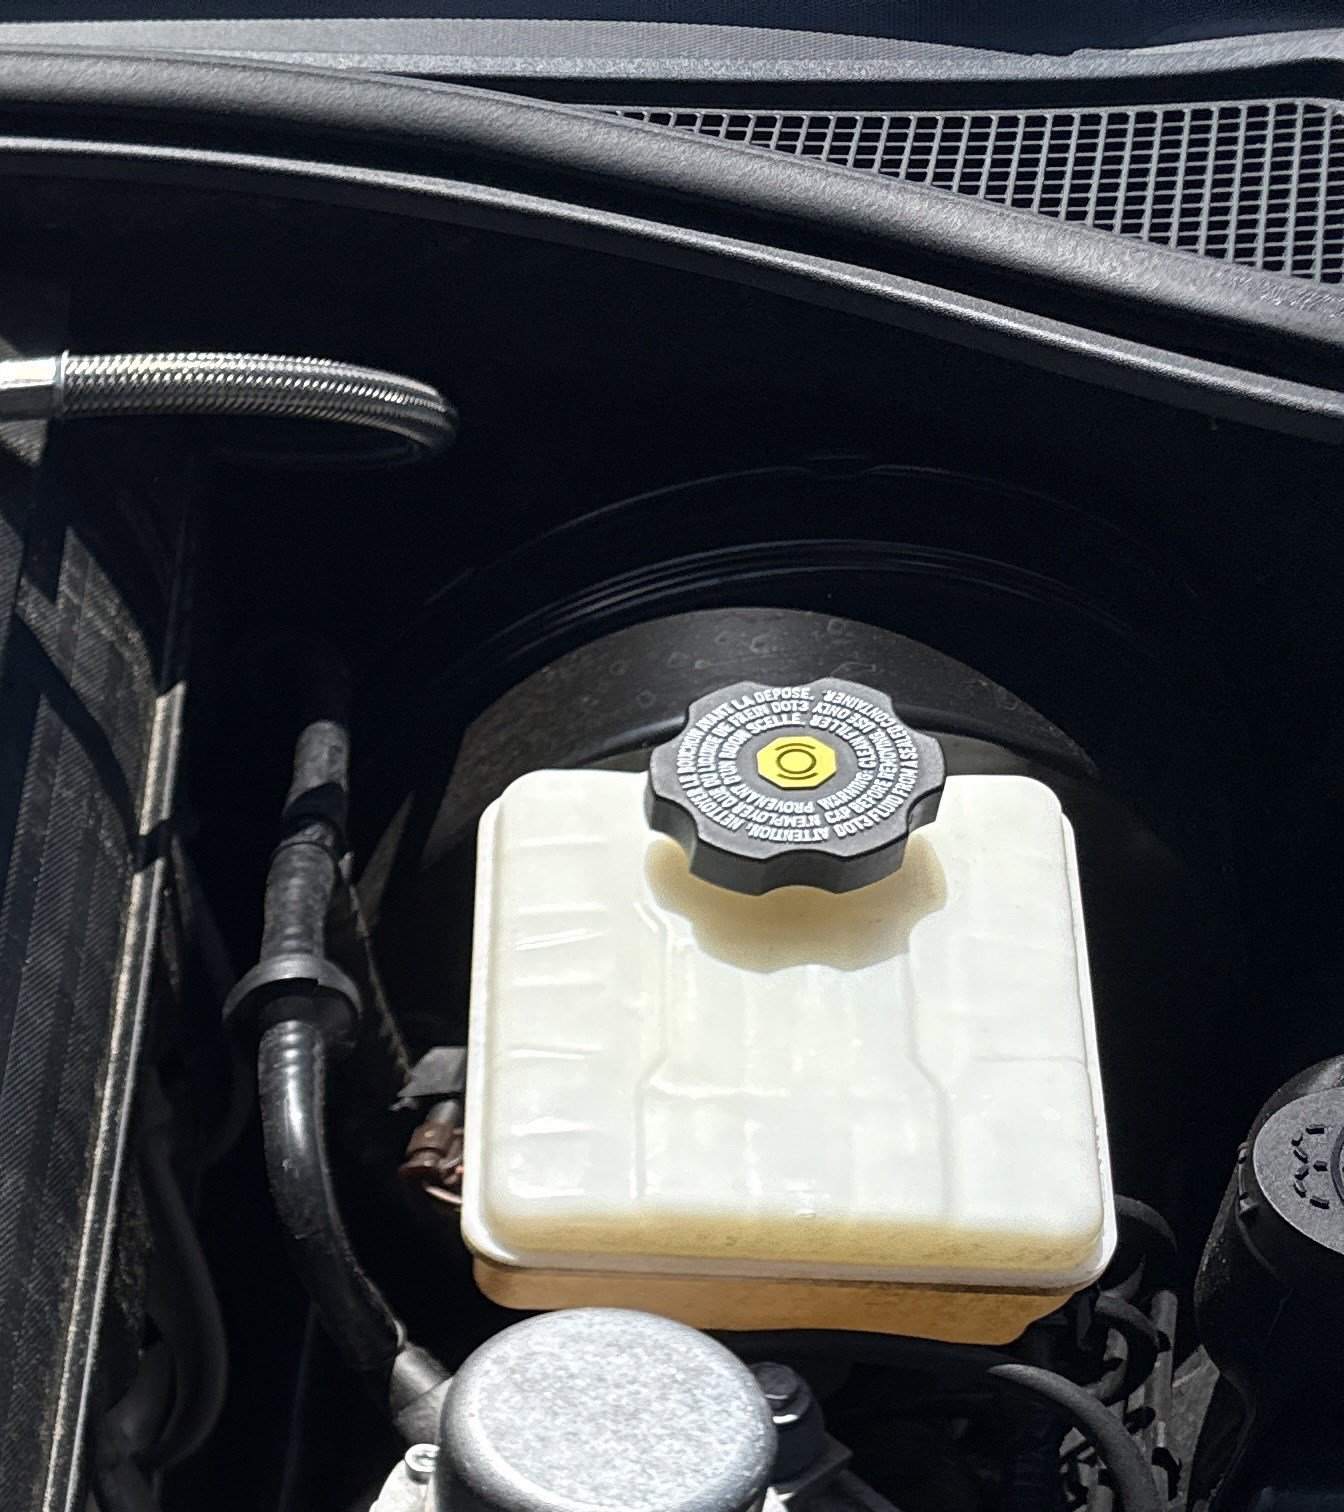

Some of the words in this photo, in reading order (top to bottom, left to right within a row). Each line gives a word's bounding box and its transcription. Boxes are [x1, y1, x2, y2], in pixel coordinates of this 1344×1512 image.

[727, 703, 770, 728] FREIN
[731, 696, 756, 711] LA
[771, 700, 809, 713] DOT3
[812, 701, 854, 721] ONLY
[695, 702, 736, 732] AVANT
[711, 721, 735, 738] DE
[809, 714, 860, 742] FILLER
[847, 712, 878, 734] USE
[677, 727, 705, 774] BOUCHON
[697, 734, 723, 773] LIQUIDE
[848, 736, 878, 769] CLEAN
[886, 726, 918, 761] SEALED
[679, 774, 701, 789] LE
[699, 773, 721, 788] DU
[892, 769, 918, 799] FROM
[686, 787, 746, 832] NETTOYER
[708, 785, 739, 808] QUE
[729, 783, 816, 813] PROVENANT
[848, 779, 893, 814] BEFORE
[868, 794, 905, 824] FLUID
[824, 806, 852, 825] CAP
[832, 816, 874, 838] DOT3
